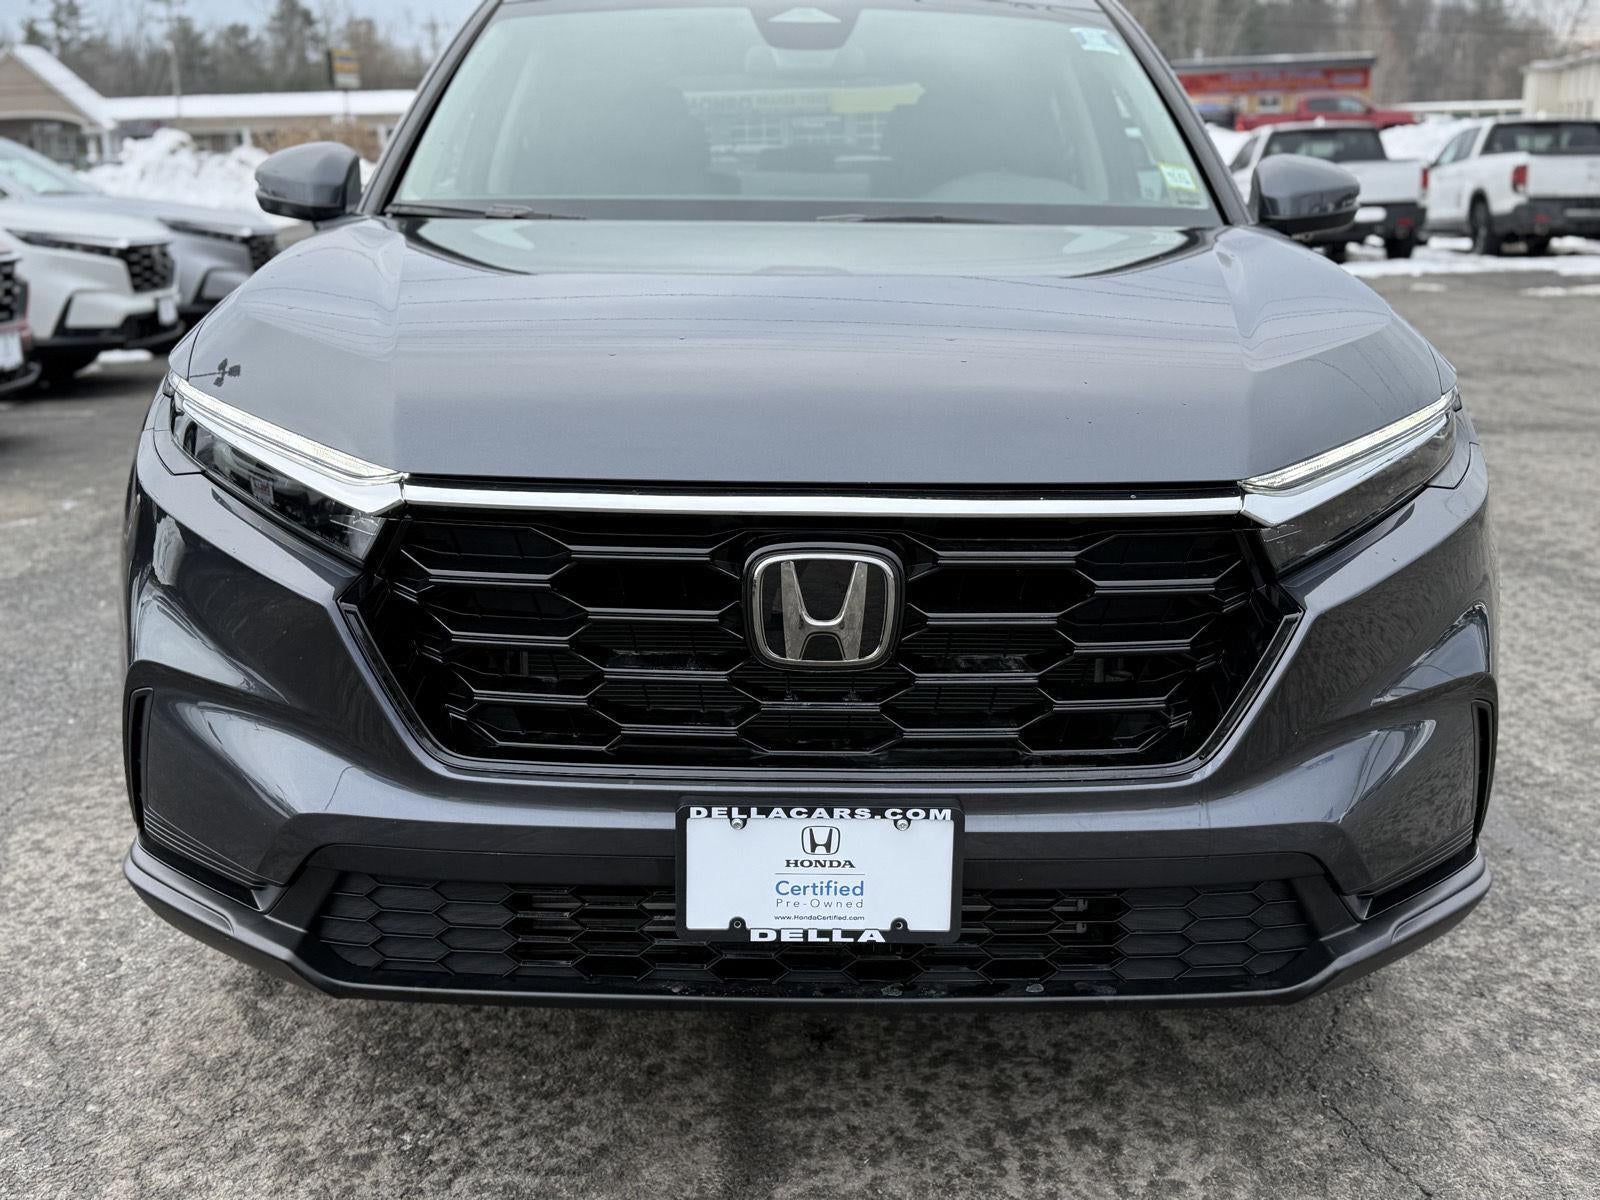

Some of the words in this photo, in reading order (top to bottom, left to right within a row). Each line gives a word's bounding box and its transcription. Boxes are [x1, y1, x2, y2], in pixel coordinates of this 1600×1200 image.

[690, 807, 951, 820] DELLACARS.COM
[785, 859, 856, 869] HONDA
[775, 880, 865, 897] Certified
[776, 898, 864, 909] Pre-Owned
[750, 928, 886, 943] DELLA
